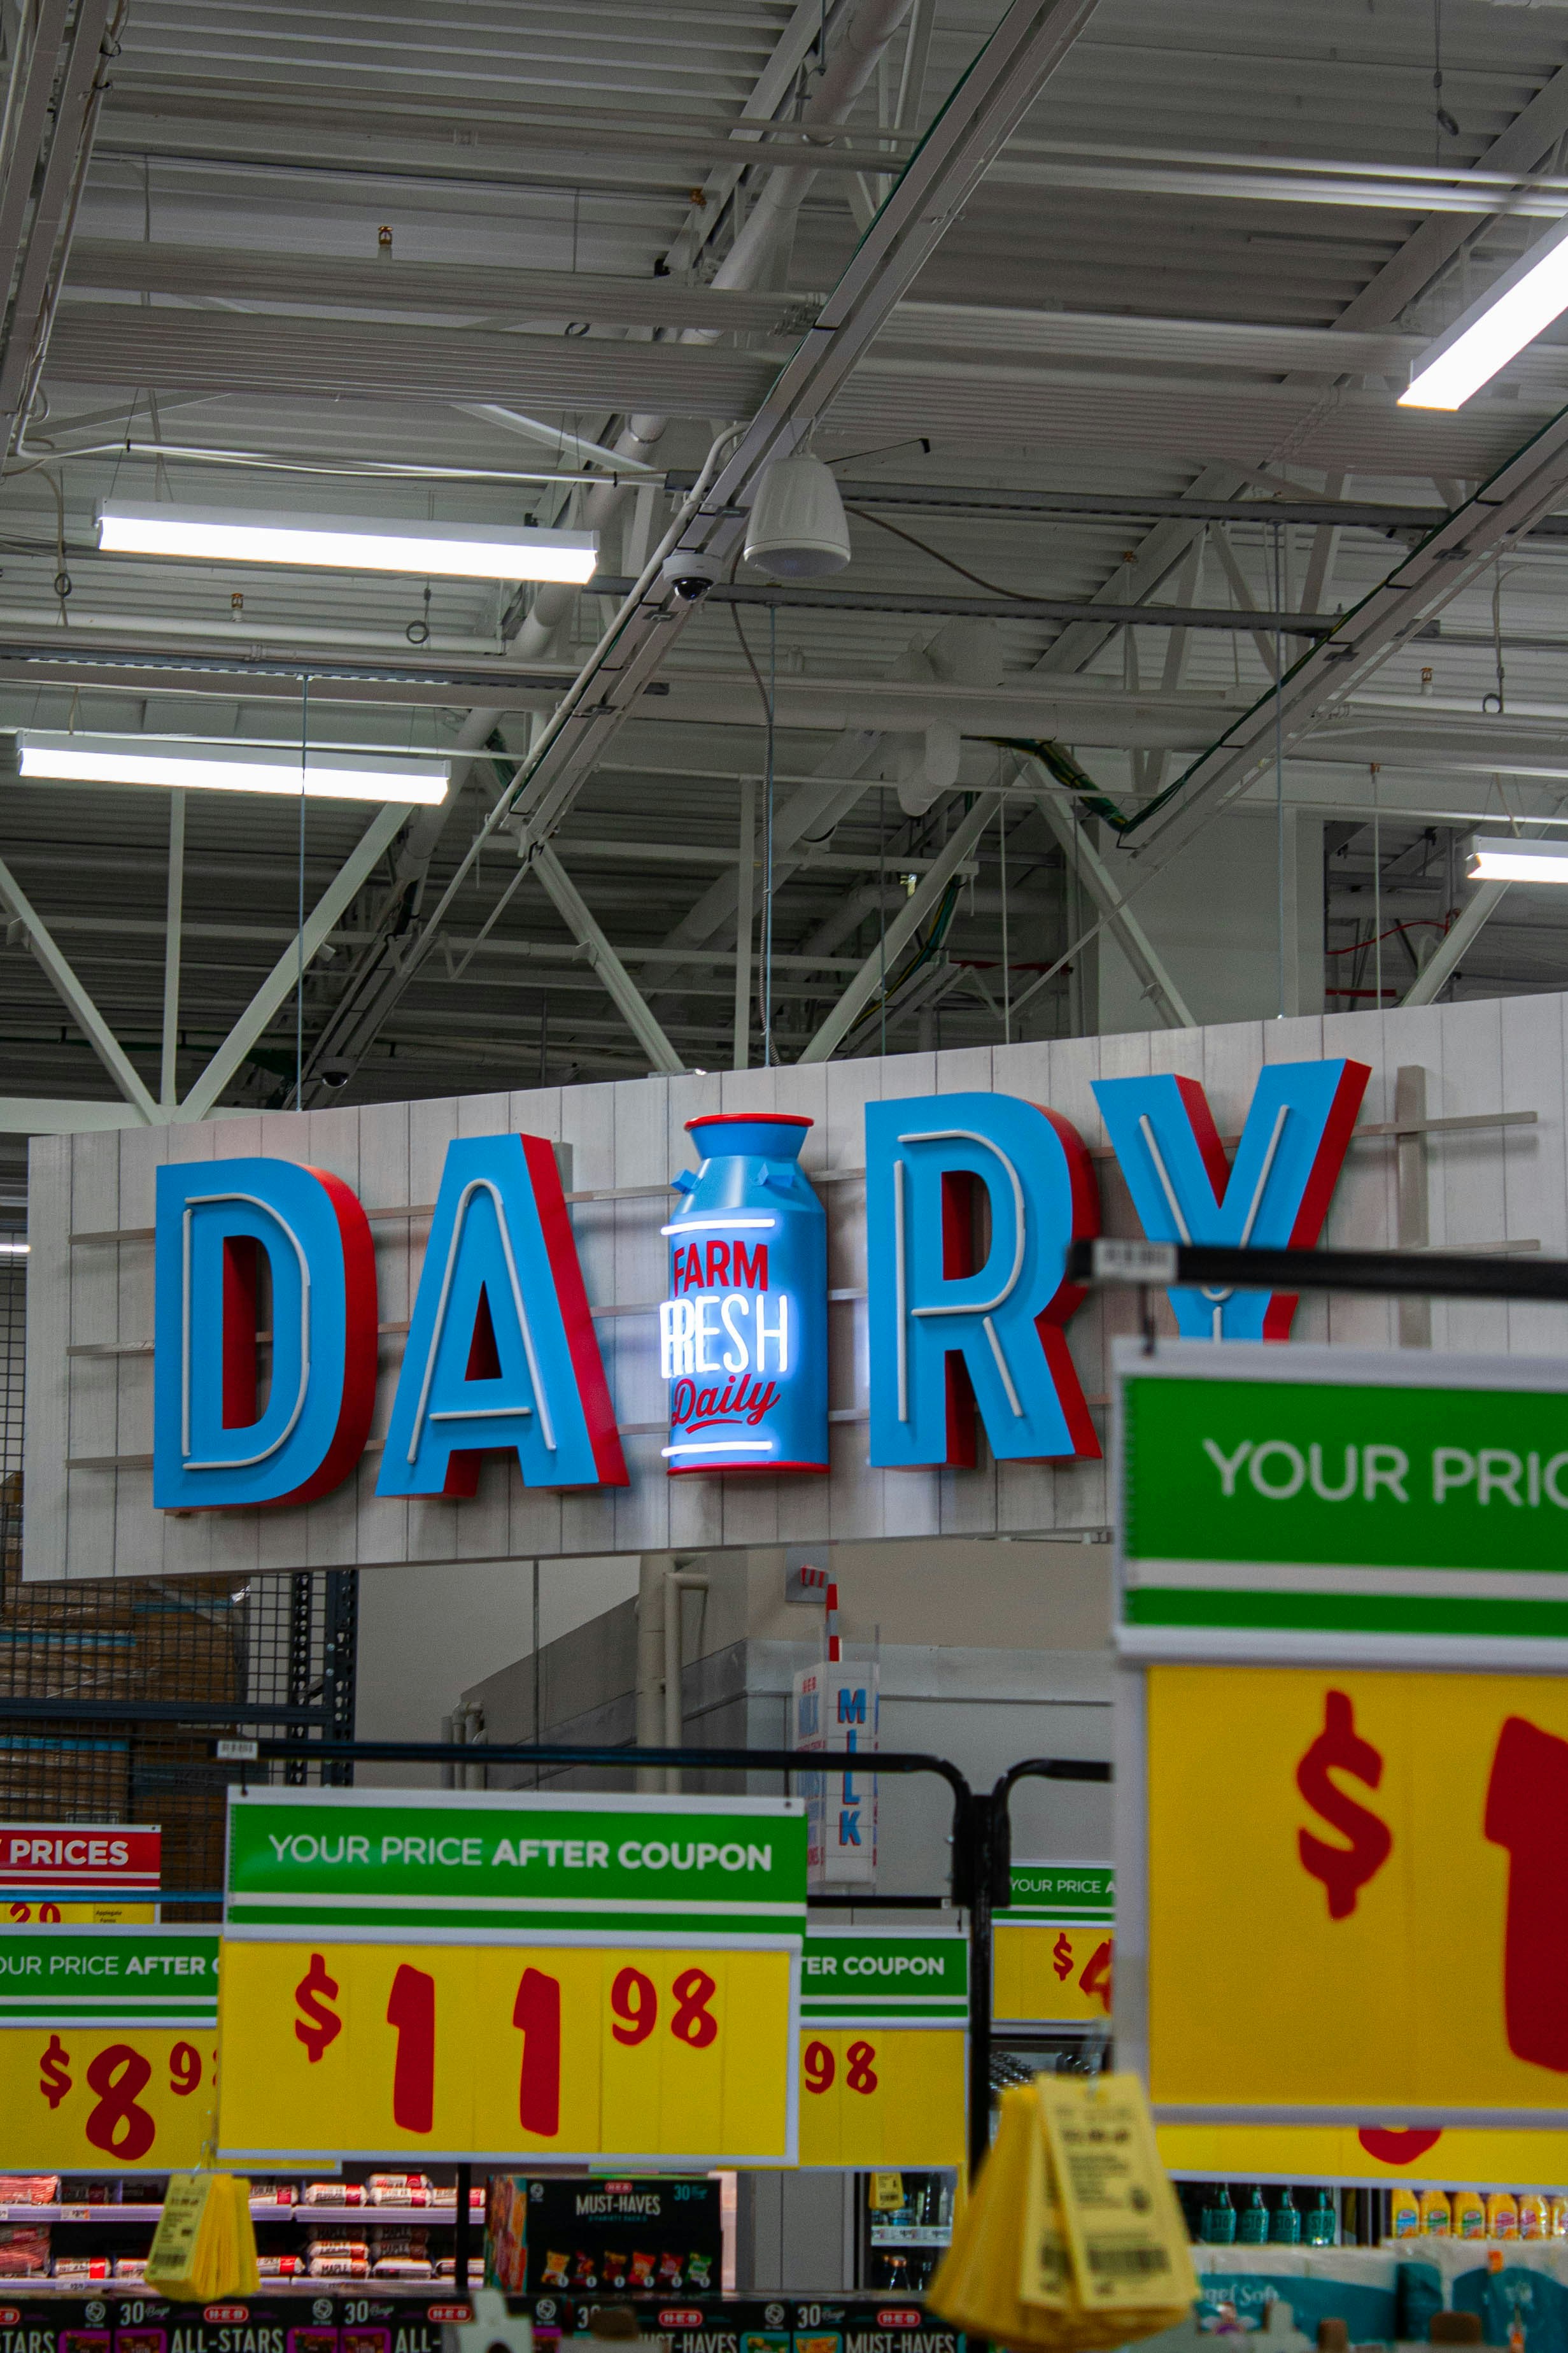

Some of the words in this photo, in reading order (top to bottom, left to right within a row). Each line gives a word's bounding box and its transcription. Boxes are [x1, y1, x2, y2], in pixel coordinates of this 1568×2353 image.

[674, 1240, 769, 1297] FARM
[660, 1293, 788, 1379] FRESH
[671, 1373, 782, 1428] Daily
[1202, 1437, 1410, 1504] YOUR
[10, 1839, 129, 1866] PRICES
[269, 1834, 369, 1864] YOUR
[381, 1837, 483, 1866] PRICE
[491, 1838, 609, 1868] AFTER
[618, 1841, 772, 1872] COUPON
[1010, 1879, 1053, 1893] YOUR
[1057, 1880, 1101, 1894] PRICE
[50, 1956, 119, 1975] PRICE
[125, 1956, 205, 1976] AFTER
[843, 1957, 945, 1976] COUPON
[611, 1966, 718, 2049] 98
[575, 2194, 661, 2216] MUST-HAVES
[674, 2184, 691, 2201] 30
[120, 2300, 145, 2326] 30
[344, 2299, 370, 2325] 30
[798, 2303, 821, 2329] 30
[171, 2328, 284, 2353] ALL-STARS
[845, 2333, 955, 2353] MUST-HAVES
